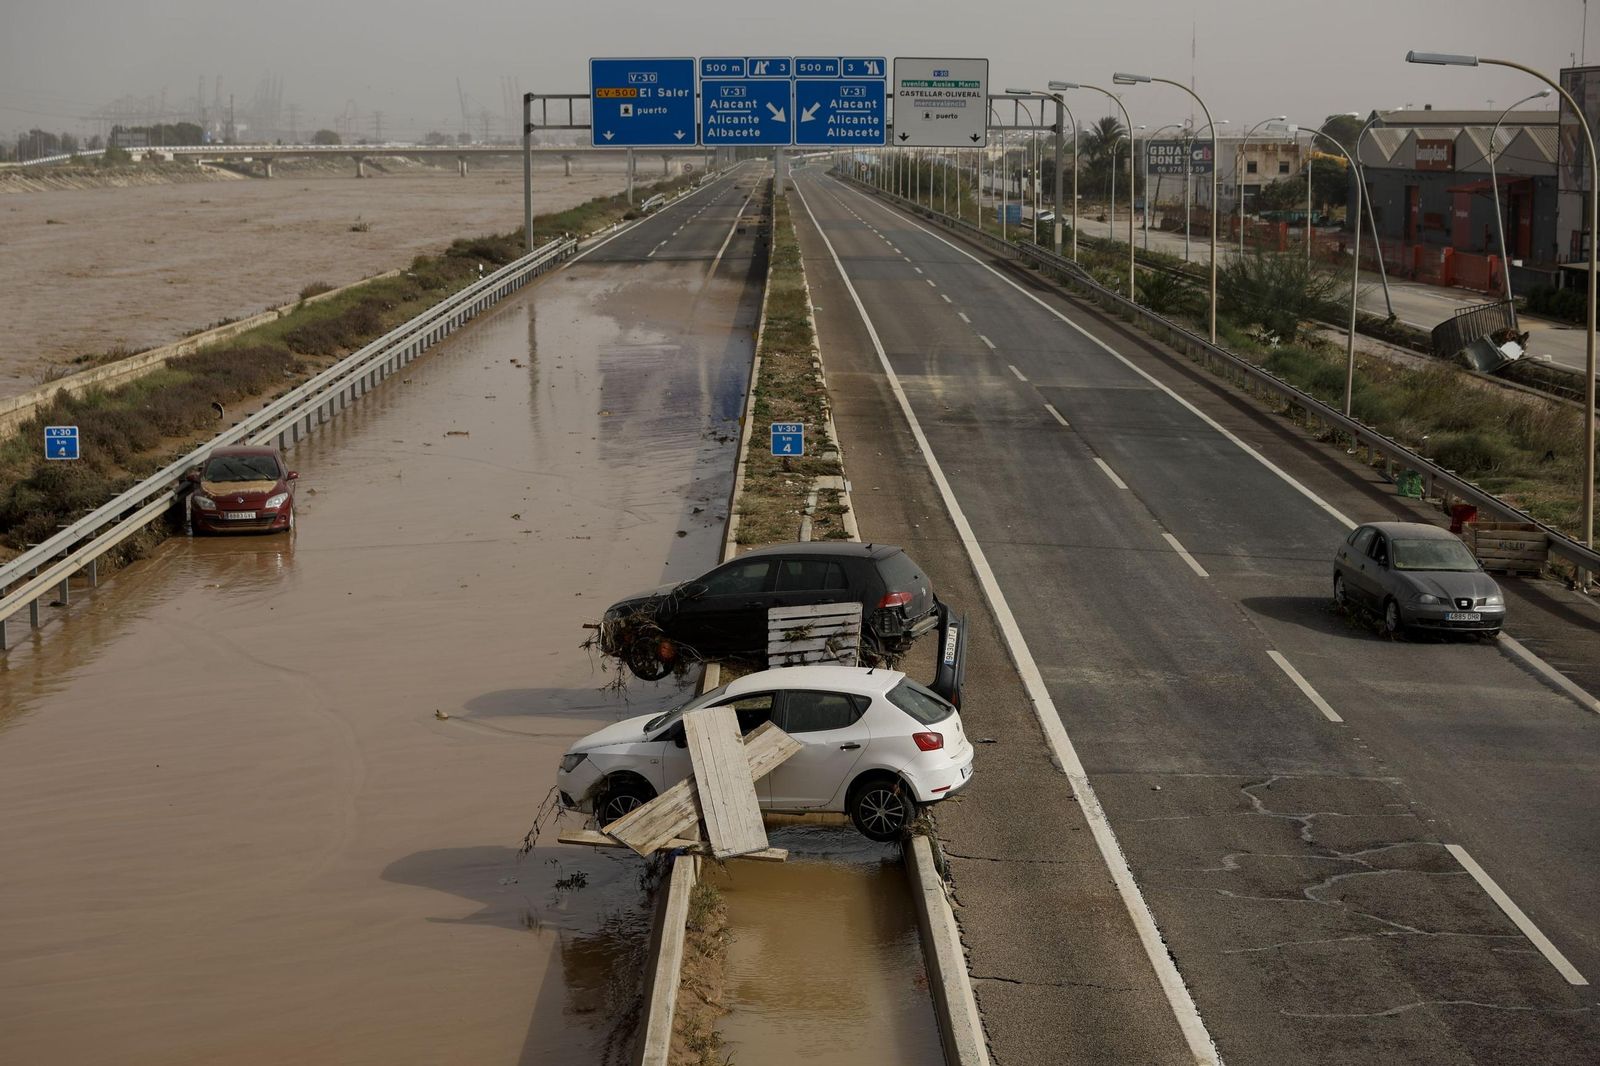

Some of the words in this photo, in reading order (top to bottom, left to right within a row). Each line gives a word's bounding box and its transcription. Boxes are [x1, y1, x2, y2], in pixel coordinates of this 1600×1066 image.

[596, 89, 636, 97] CV-500
[640, 88, 652, 97] El
[658, 88, 689, 97] Saler
[722, 88, 745, 96] V-31
[842, 88, 864, 96] V-31
[710, 100, 758, 108] Alacant
[830, 99, 877, 108] Alacant
[637, 106, 668, 116] puerto
[708, 114, 760, 124] Alicante
[828, 114, 879, 124] Alicante
[708, 128, 760, 137] Albacete
[827, 128, 880, 137] Albacete
[58, 447, 66, 457] 4
[783, 443, 792, 453] 4
